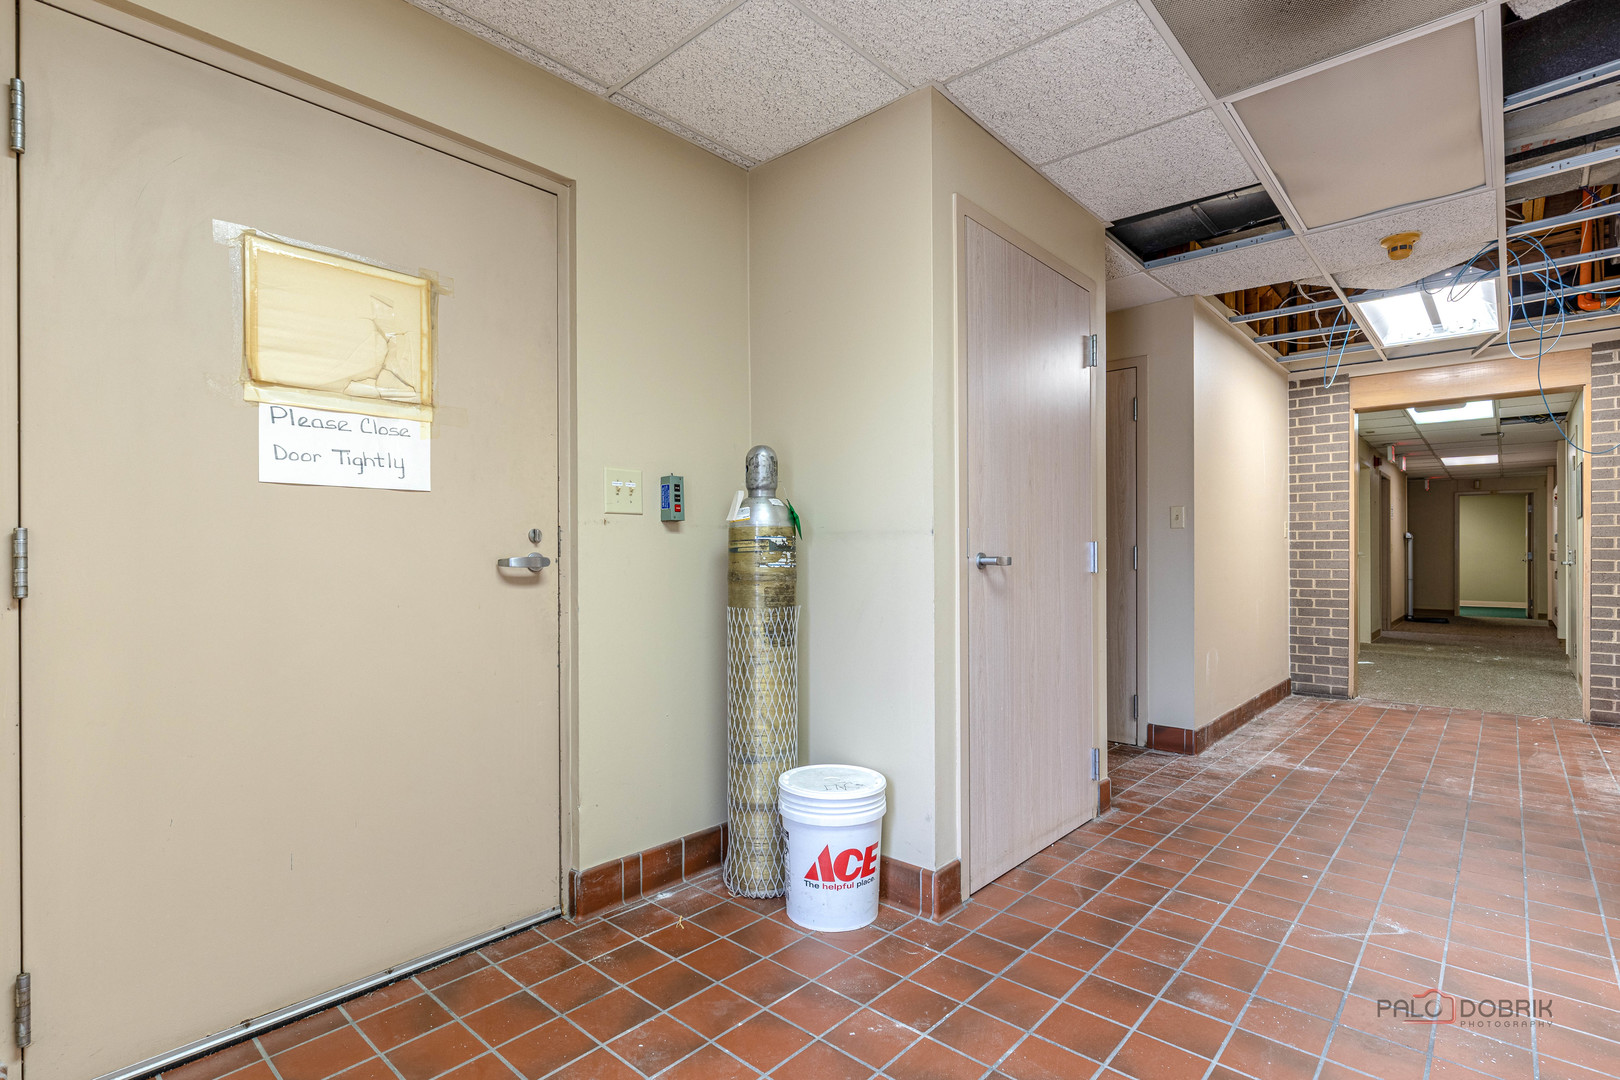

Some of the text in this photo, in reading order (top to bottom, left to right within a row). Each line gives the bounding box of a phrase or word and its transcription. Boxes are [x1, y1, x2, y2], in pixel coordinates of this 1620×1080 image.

[269, 405, 411, 438] Please Close
[273, 444, 406, 479] Door Tightly
[804, 841, 879, 882] ACE
[804, 879, 820, 889] The
[822, 882, 854, 891] helpful
